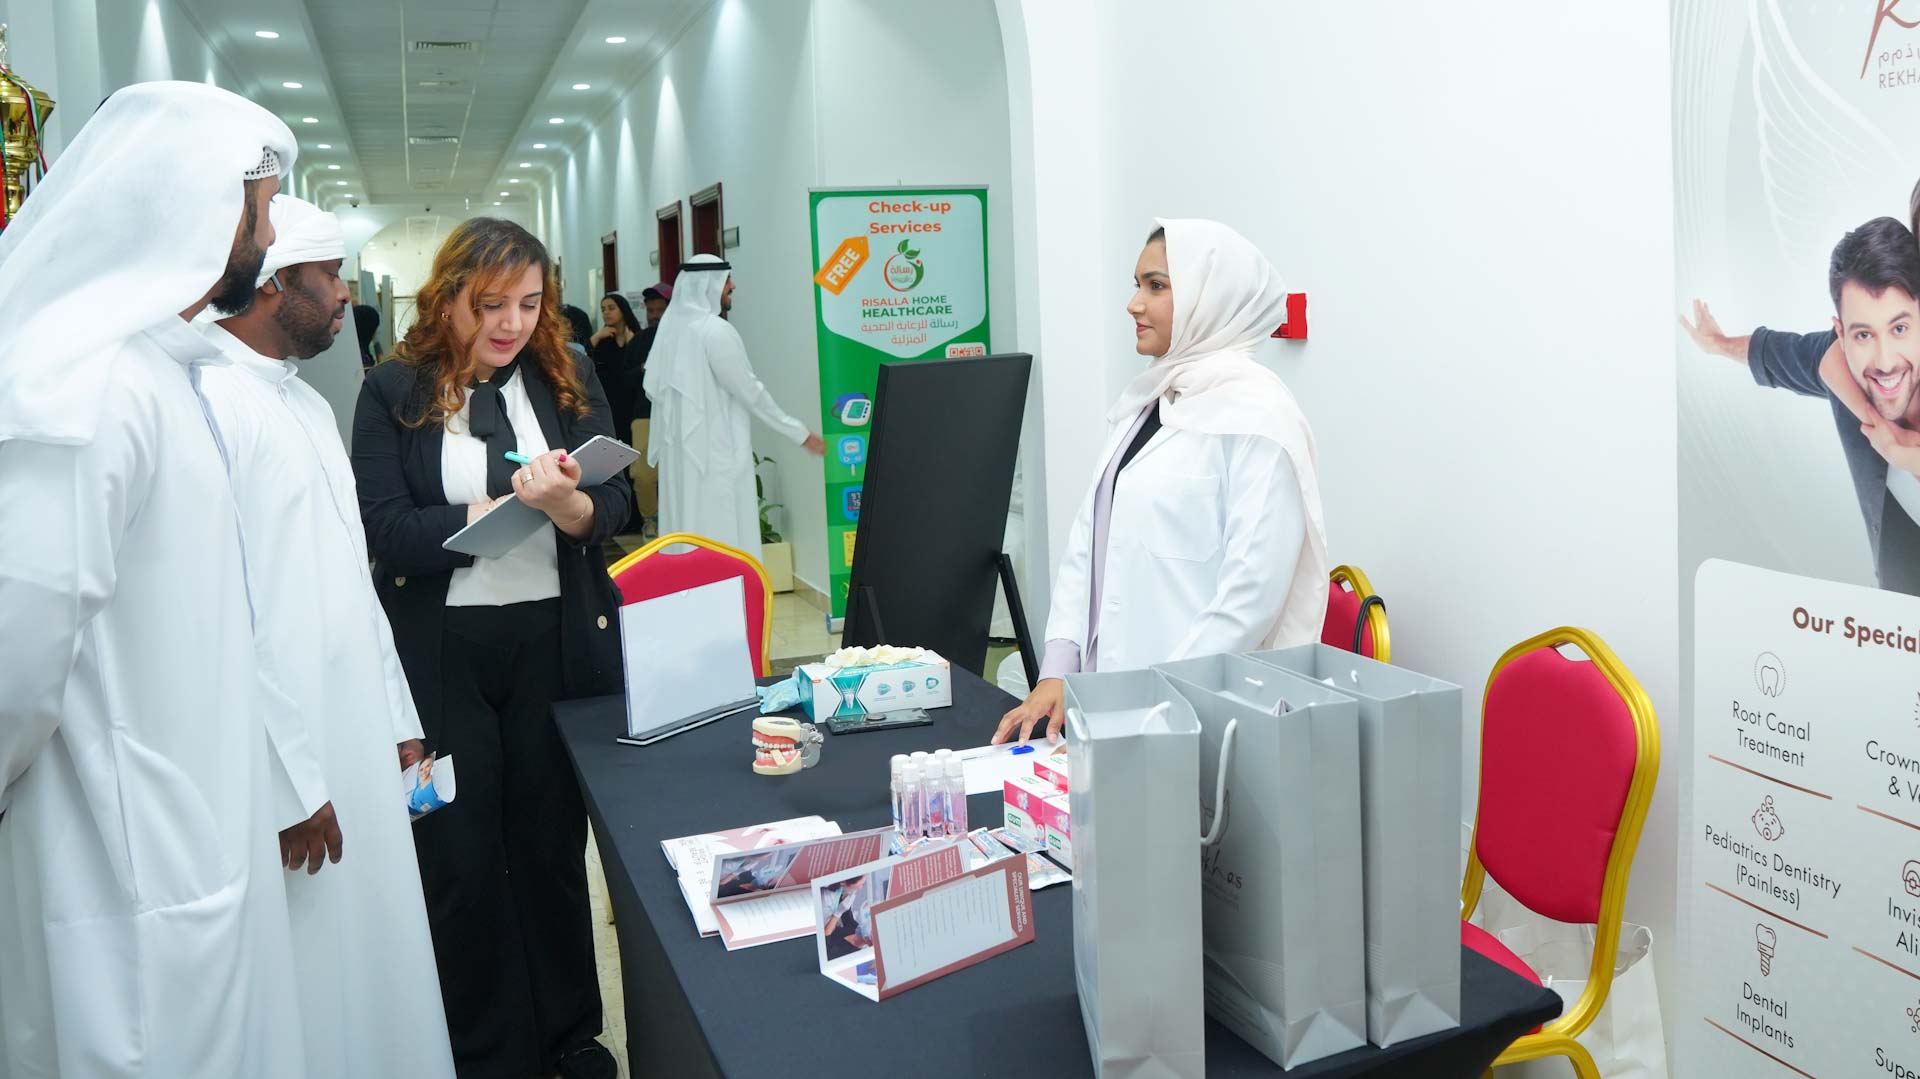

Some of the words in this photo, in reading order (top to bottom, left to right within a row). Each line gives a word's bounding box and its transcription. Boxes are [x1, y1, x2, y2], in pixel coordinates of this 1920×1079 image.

[1879, 68, 1920, 89] REKH
[868, 200, 951, 215] Check-up
[869, 220, 942, 234] Services
[825, 247, 861, 286] FREE
[861, 297, 909, 307] RISALLA
[912, 296, 947, 304] HOME
[862, 305, 953, 318] HEALTHCARE
[861, 321, 894, 332] الصحية
[896, 319, 928, 331] للرعاية
[929, 318, 958, 329] رسالة
[890, 333, 927, 345] المنزلية
[1793, 607, 1834, 634] Our
[1733, 700, 1761, 726] Root
[1766, 712, 1810, 742] Canal
[1737, 728, 1805, 767] Treatment
[1866, 740, 1920, 774] Crown
[1889, 776, 1900, 797] &
[1908, 781, 1920, 803] V
[1201, 846, 1242, 888] khas
[1705, 824, 1768, 867] Pediatrics
[1773, 853, 1841, 899] Dentistry
[1737, 863, 1800, 911] (Painless)
[1896, 931, 1918, 956] Ali
[1744, 981, 1787, 1019] Dental
[1737, 1003, 1794, 1048] Implants
[1875, 1047, 1920, 1079] Supe
